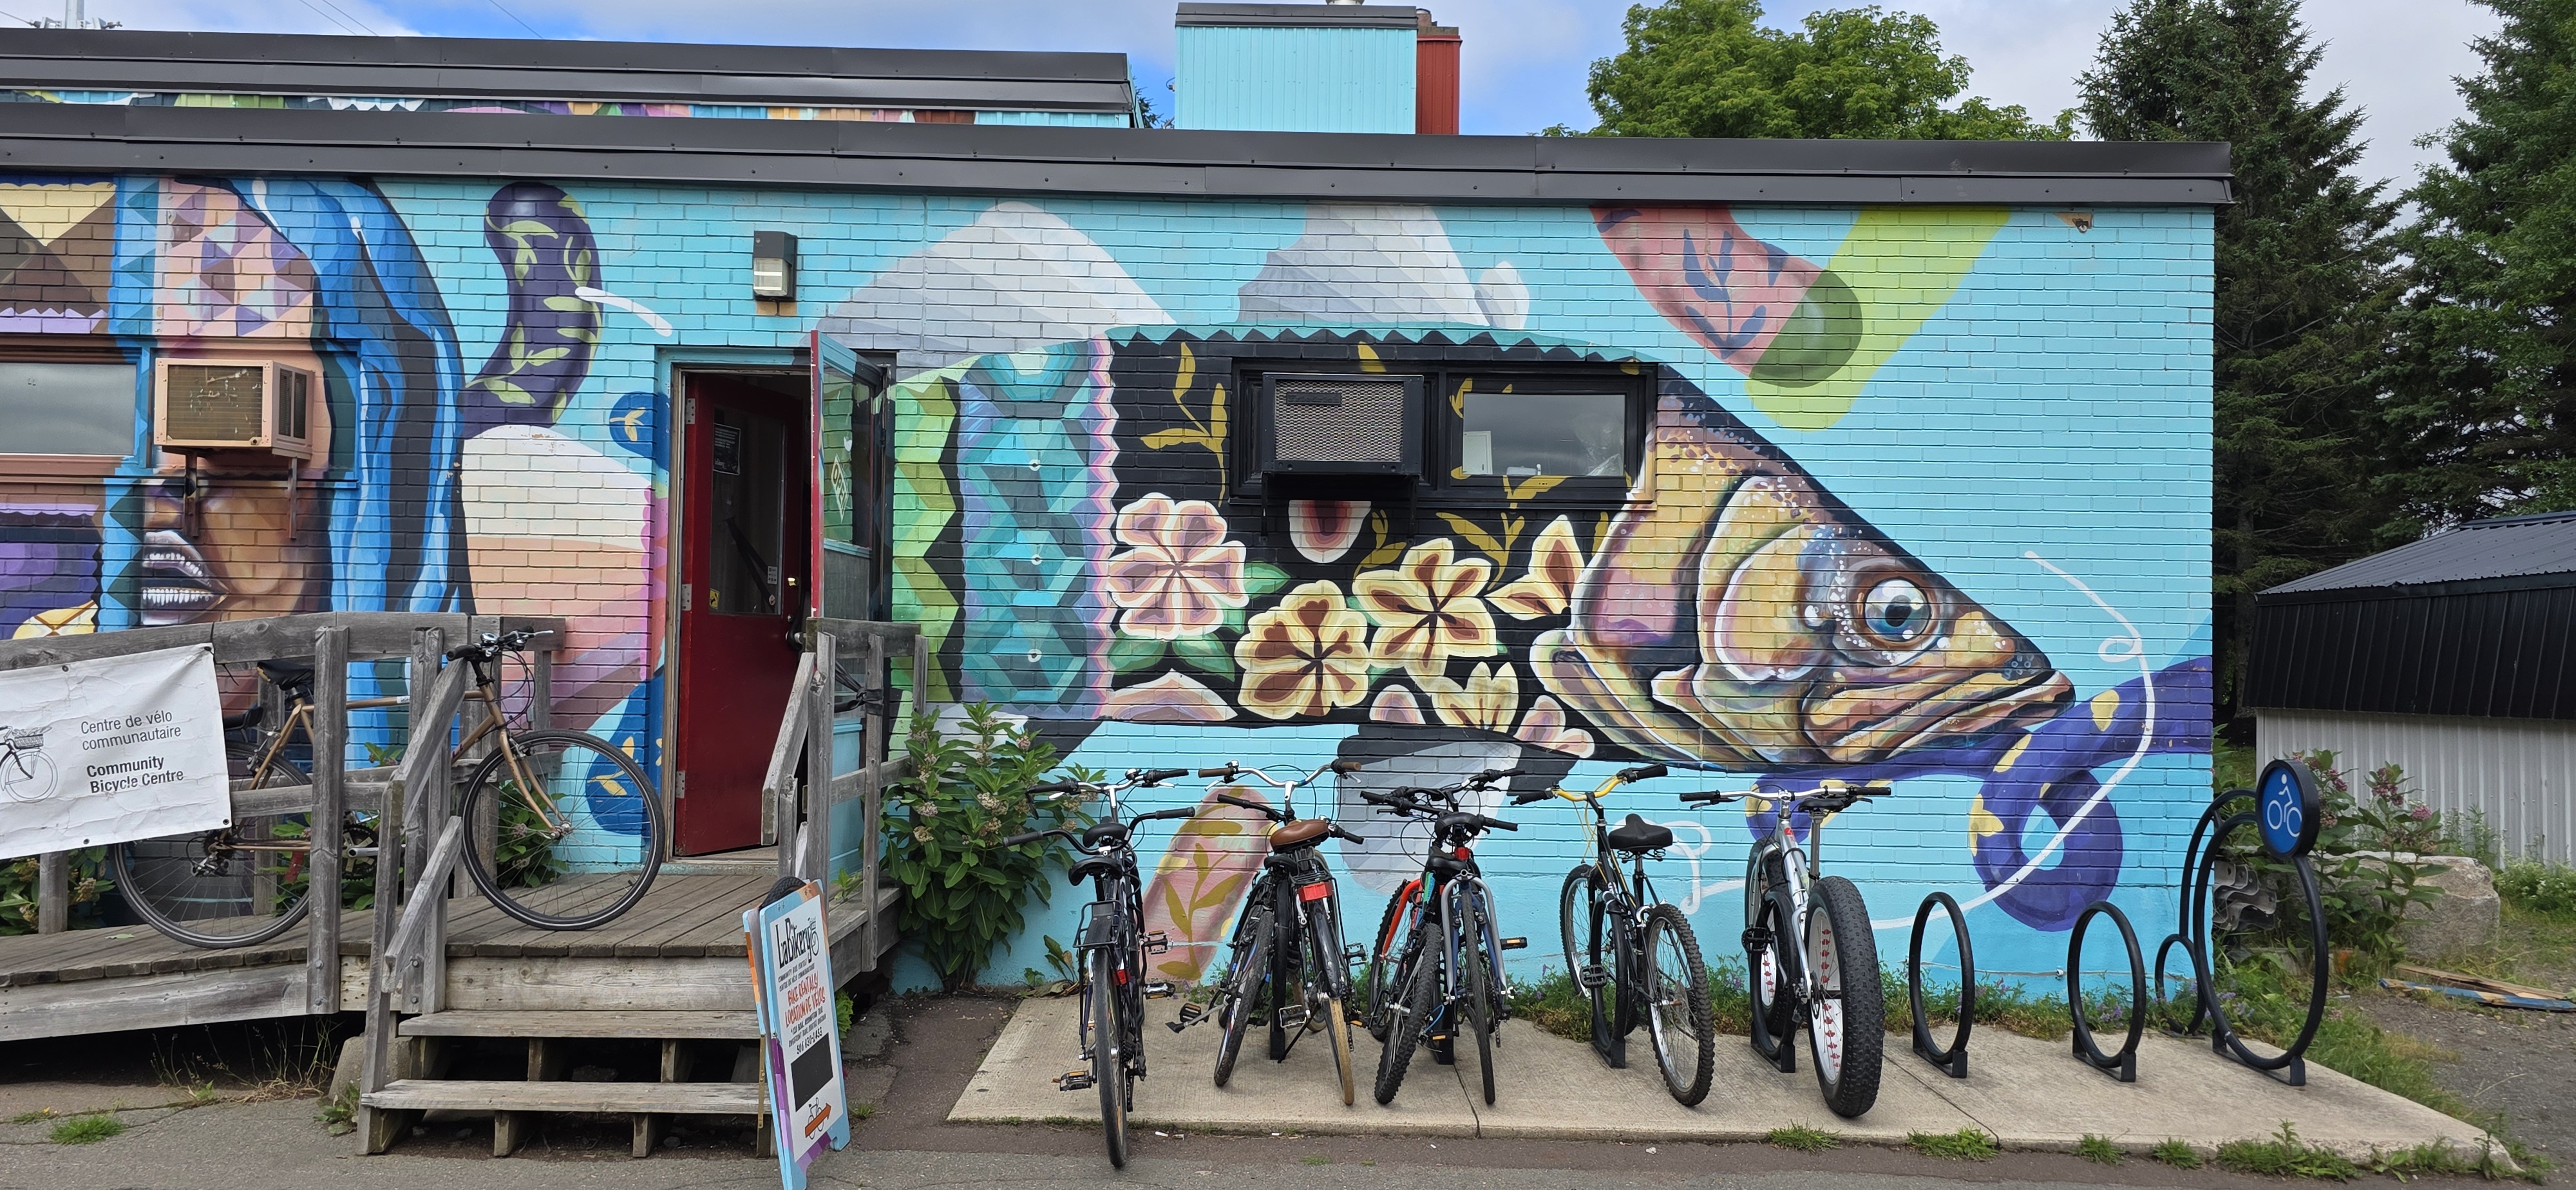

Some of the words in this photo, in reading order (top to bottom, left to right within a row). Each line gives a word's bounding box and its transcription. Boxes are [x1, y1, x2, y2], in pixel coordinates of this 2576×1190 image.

[81, 719, 121, 734] Centre
[126, 715, 142, 728] de
[146, 710, 173, 724] vélo
[82, 726, 182, 750] communautaire
[86, 756, 164, 777] Community
[90, 776, 138, 793] Bicycle
[142, 770, 184, 786] Centre
